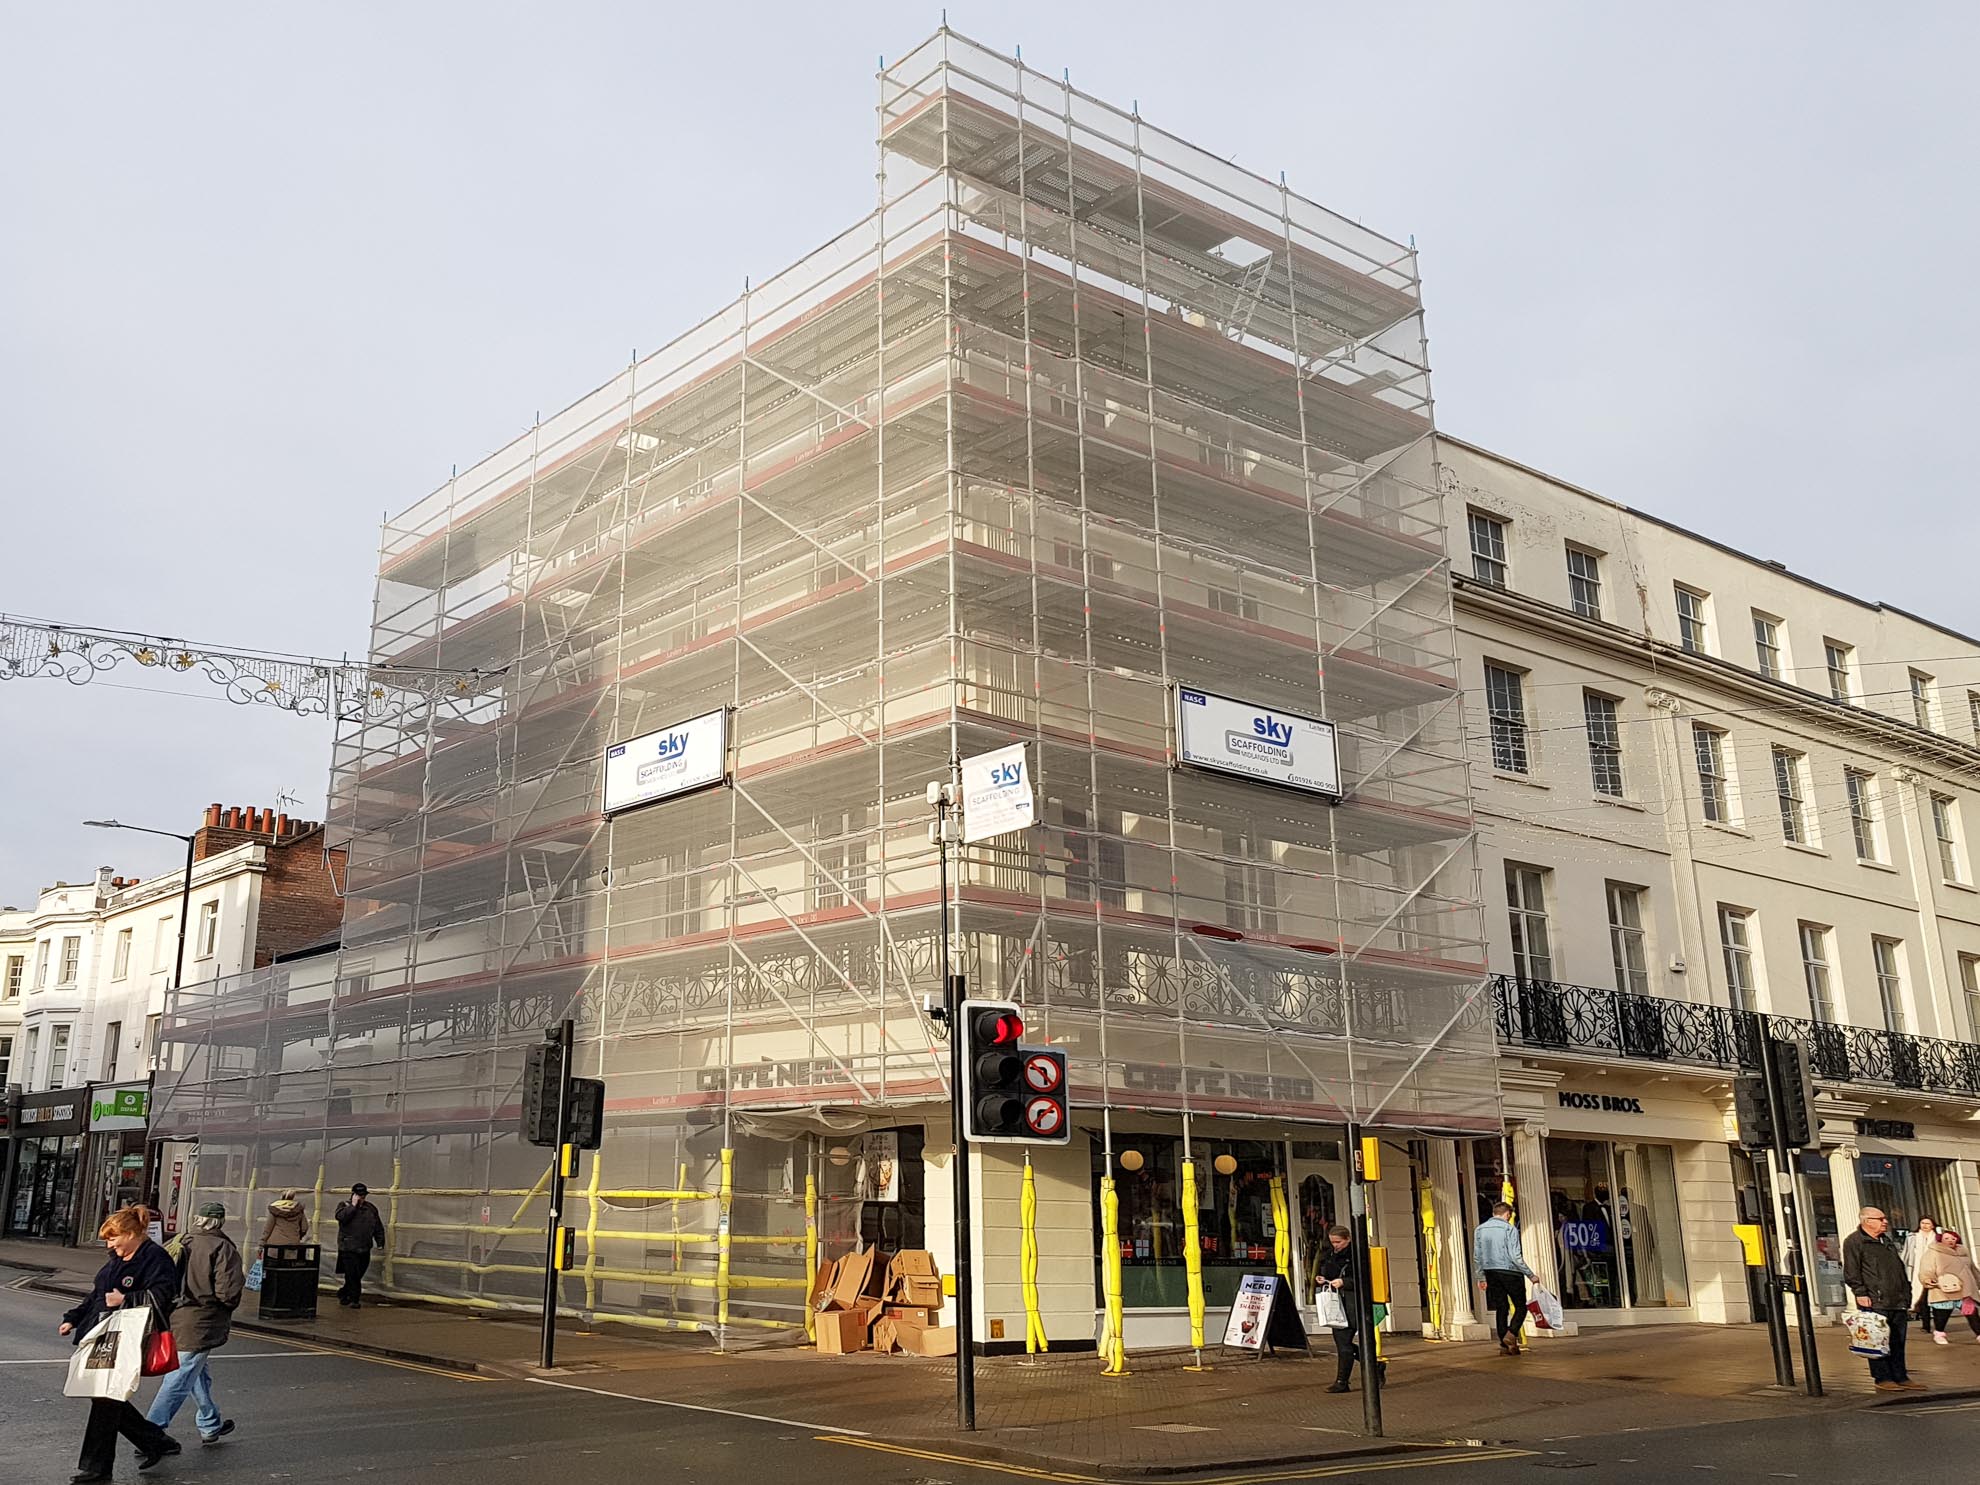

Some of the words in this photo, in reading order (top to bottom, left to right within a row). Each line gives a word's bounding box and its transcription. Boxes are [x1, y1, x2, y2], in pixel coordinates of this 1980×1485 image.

[1253, 715, 1293, 747] sky
[658, 732, 689, 757] sky
[1231, 738, 1288, 759] SCAFFOLDING
[991, 762, 1022, 784] sky
[1193, 754, 1268, 775] www.skyscaffolding.co.uk
[972, 788, 1021, 806] SCAFFOLDING
[1558, 1091, 1600, 1110] MOSS
[96, 1343, 113, 1352] M&S
